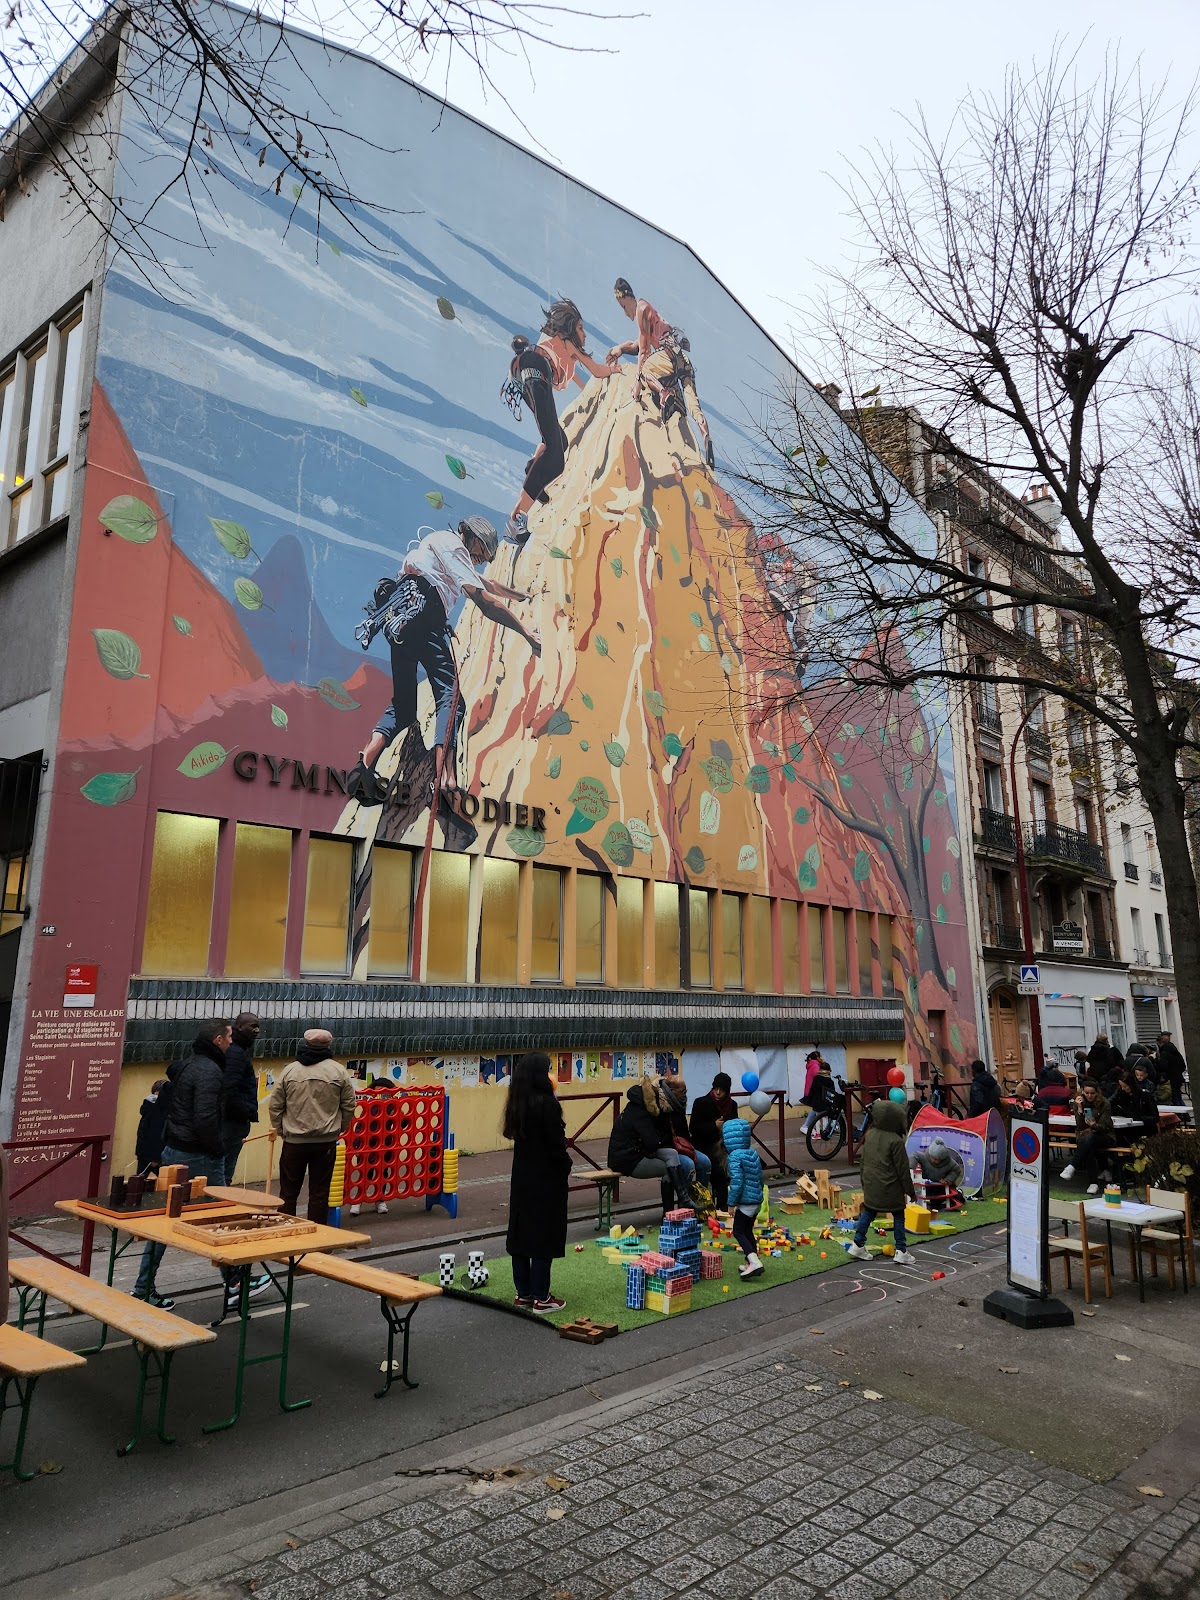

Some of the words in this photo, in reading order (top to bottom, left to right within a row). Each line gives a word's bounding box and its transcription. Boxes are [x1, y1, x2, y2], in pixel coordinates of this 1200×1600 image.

[191, 752, 219, 769] Aikido
[233, 751, 412, 806] GYMNASE
[437, 788, 547, 831] NODIER
[31, 1010, 42, 1018] LA
[44, 1010, 60, 1018] VIE
[63, 1009, 82, 1018] UNE
[83, 1009, 125, 1017] ESCALADE
